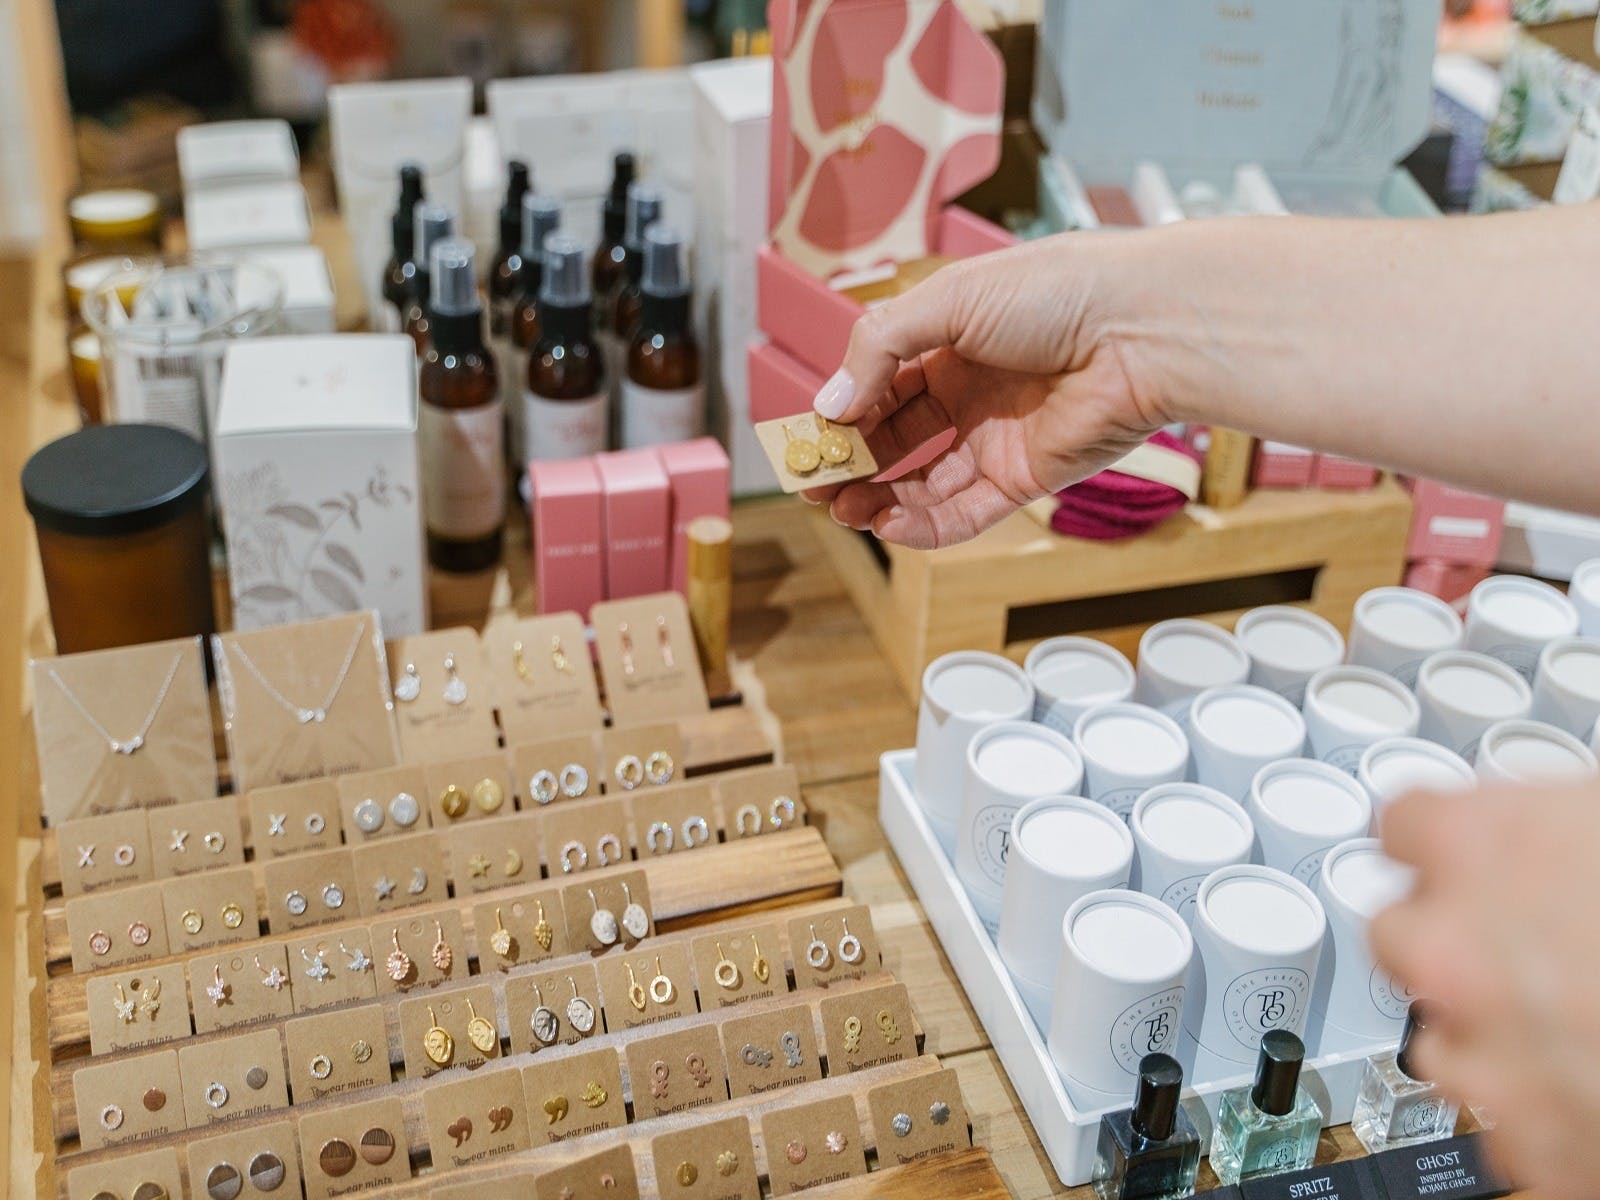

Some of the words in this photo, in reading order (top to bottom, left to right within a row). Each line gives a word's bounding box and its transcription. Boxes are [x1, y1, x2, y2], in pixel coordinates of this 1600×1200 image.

[1416, 1151, 1460, 1170] GHOST
[1417, 1182, 1449, 1195] MOJAVE
[1448, 1176, 1476, 1189] GHOST
[1420, 1171, 1455, 1184] INSPIRED
[1456, 1168, 1465, 1178] BY
[1289, 1176, 1334, 1198] SPRITZ
